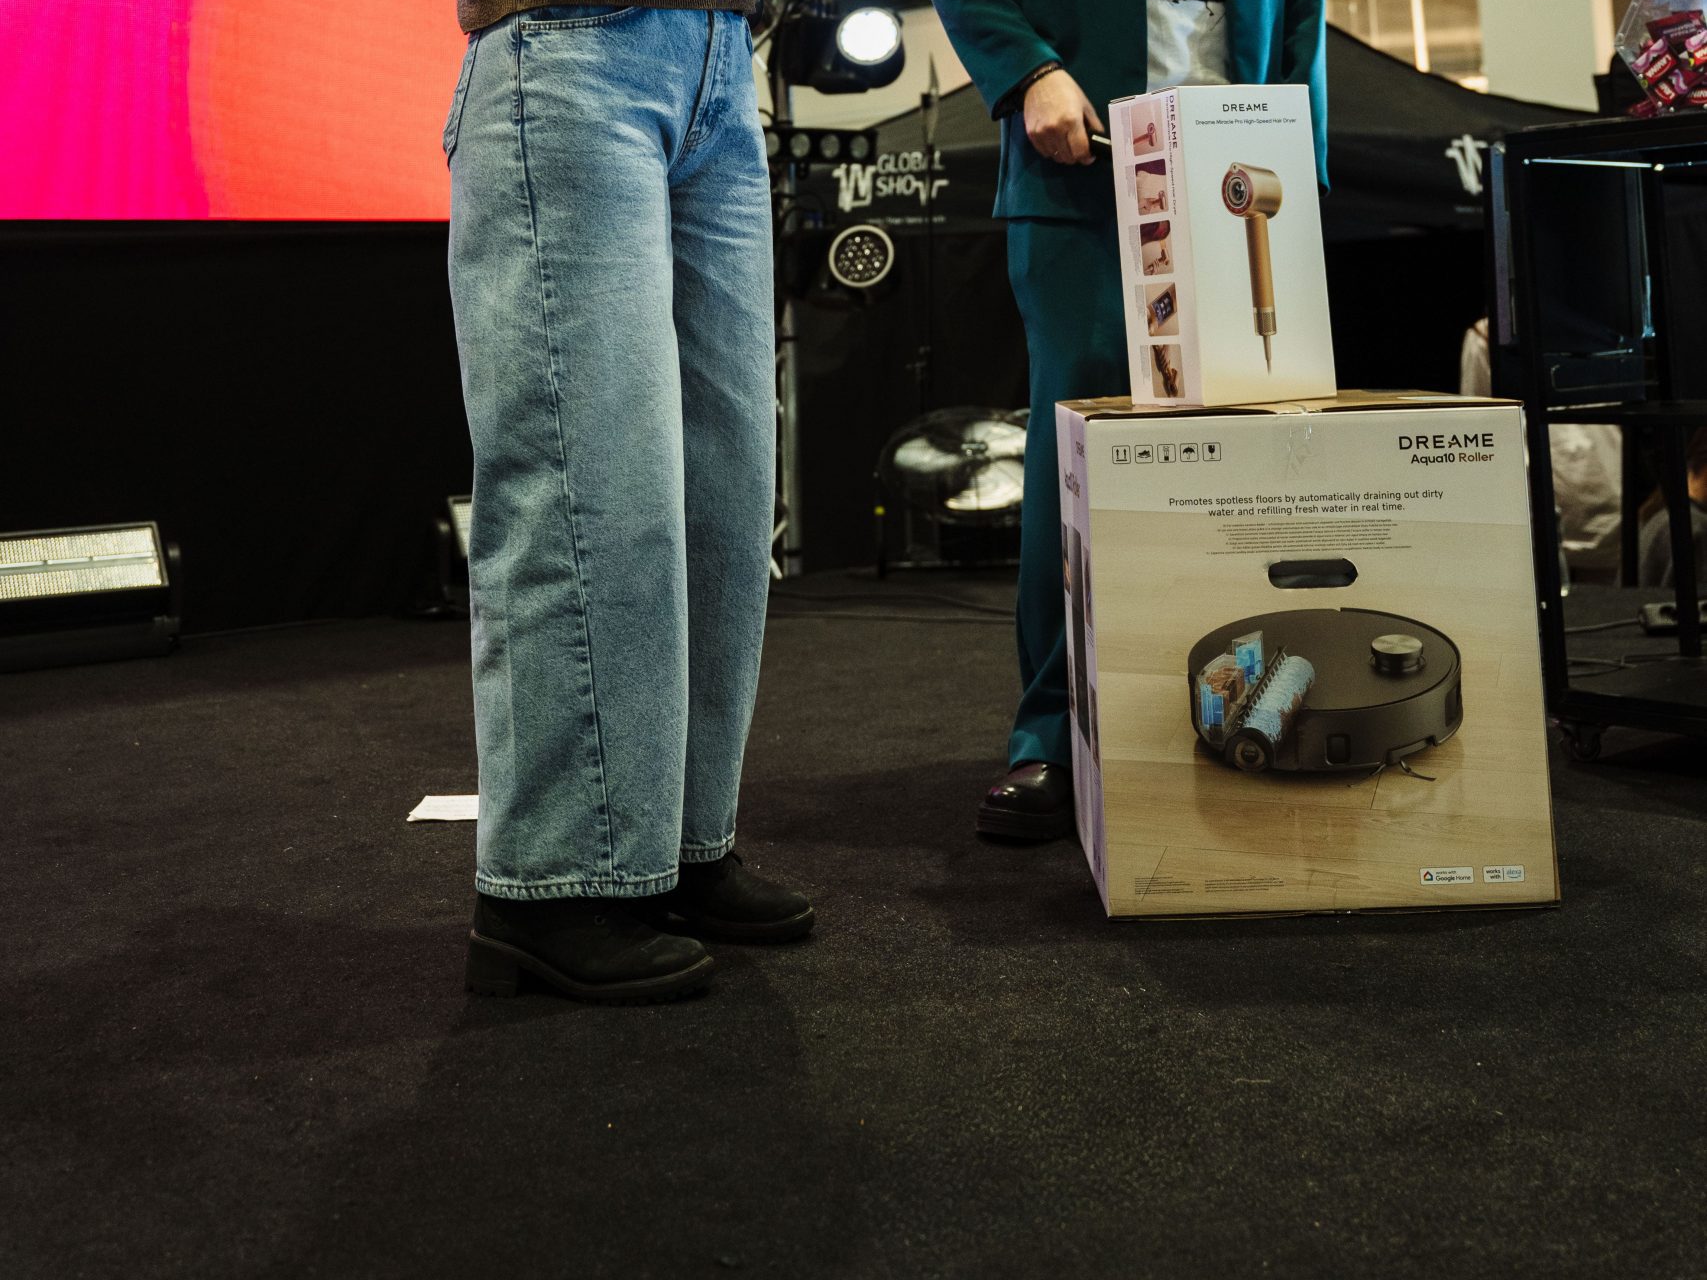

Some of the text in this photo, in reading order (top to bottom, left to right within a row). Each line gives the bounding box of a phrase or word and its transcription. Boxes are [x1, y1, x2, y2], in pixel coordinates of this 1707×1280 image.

[1222, 103, 1269, 112] DREAME
[1169, 95, 1178, 149] DREAME
[1243, 118, 1272, 126] High-Speed
[1398, 433, 1494, 450] DREAME
[1410, 452, 1495, 466] Aqua10 Roller
[1168, 489, 1444, 506] Promotes spotless floors by automatically draining out dirty
[1208, 502, 1405, 517] water and refilling fresh water in real time.
